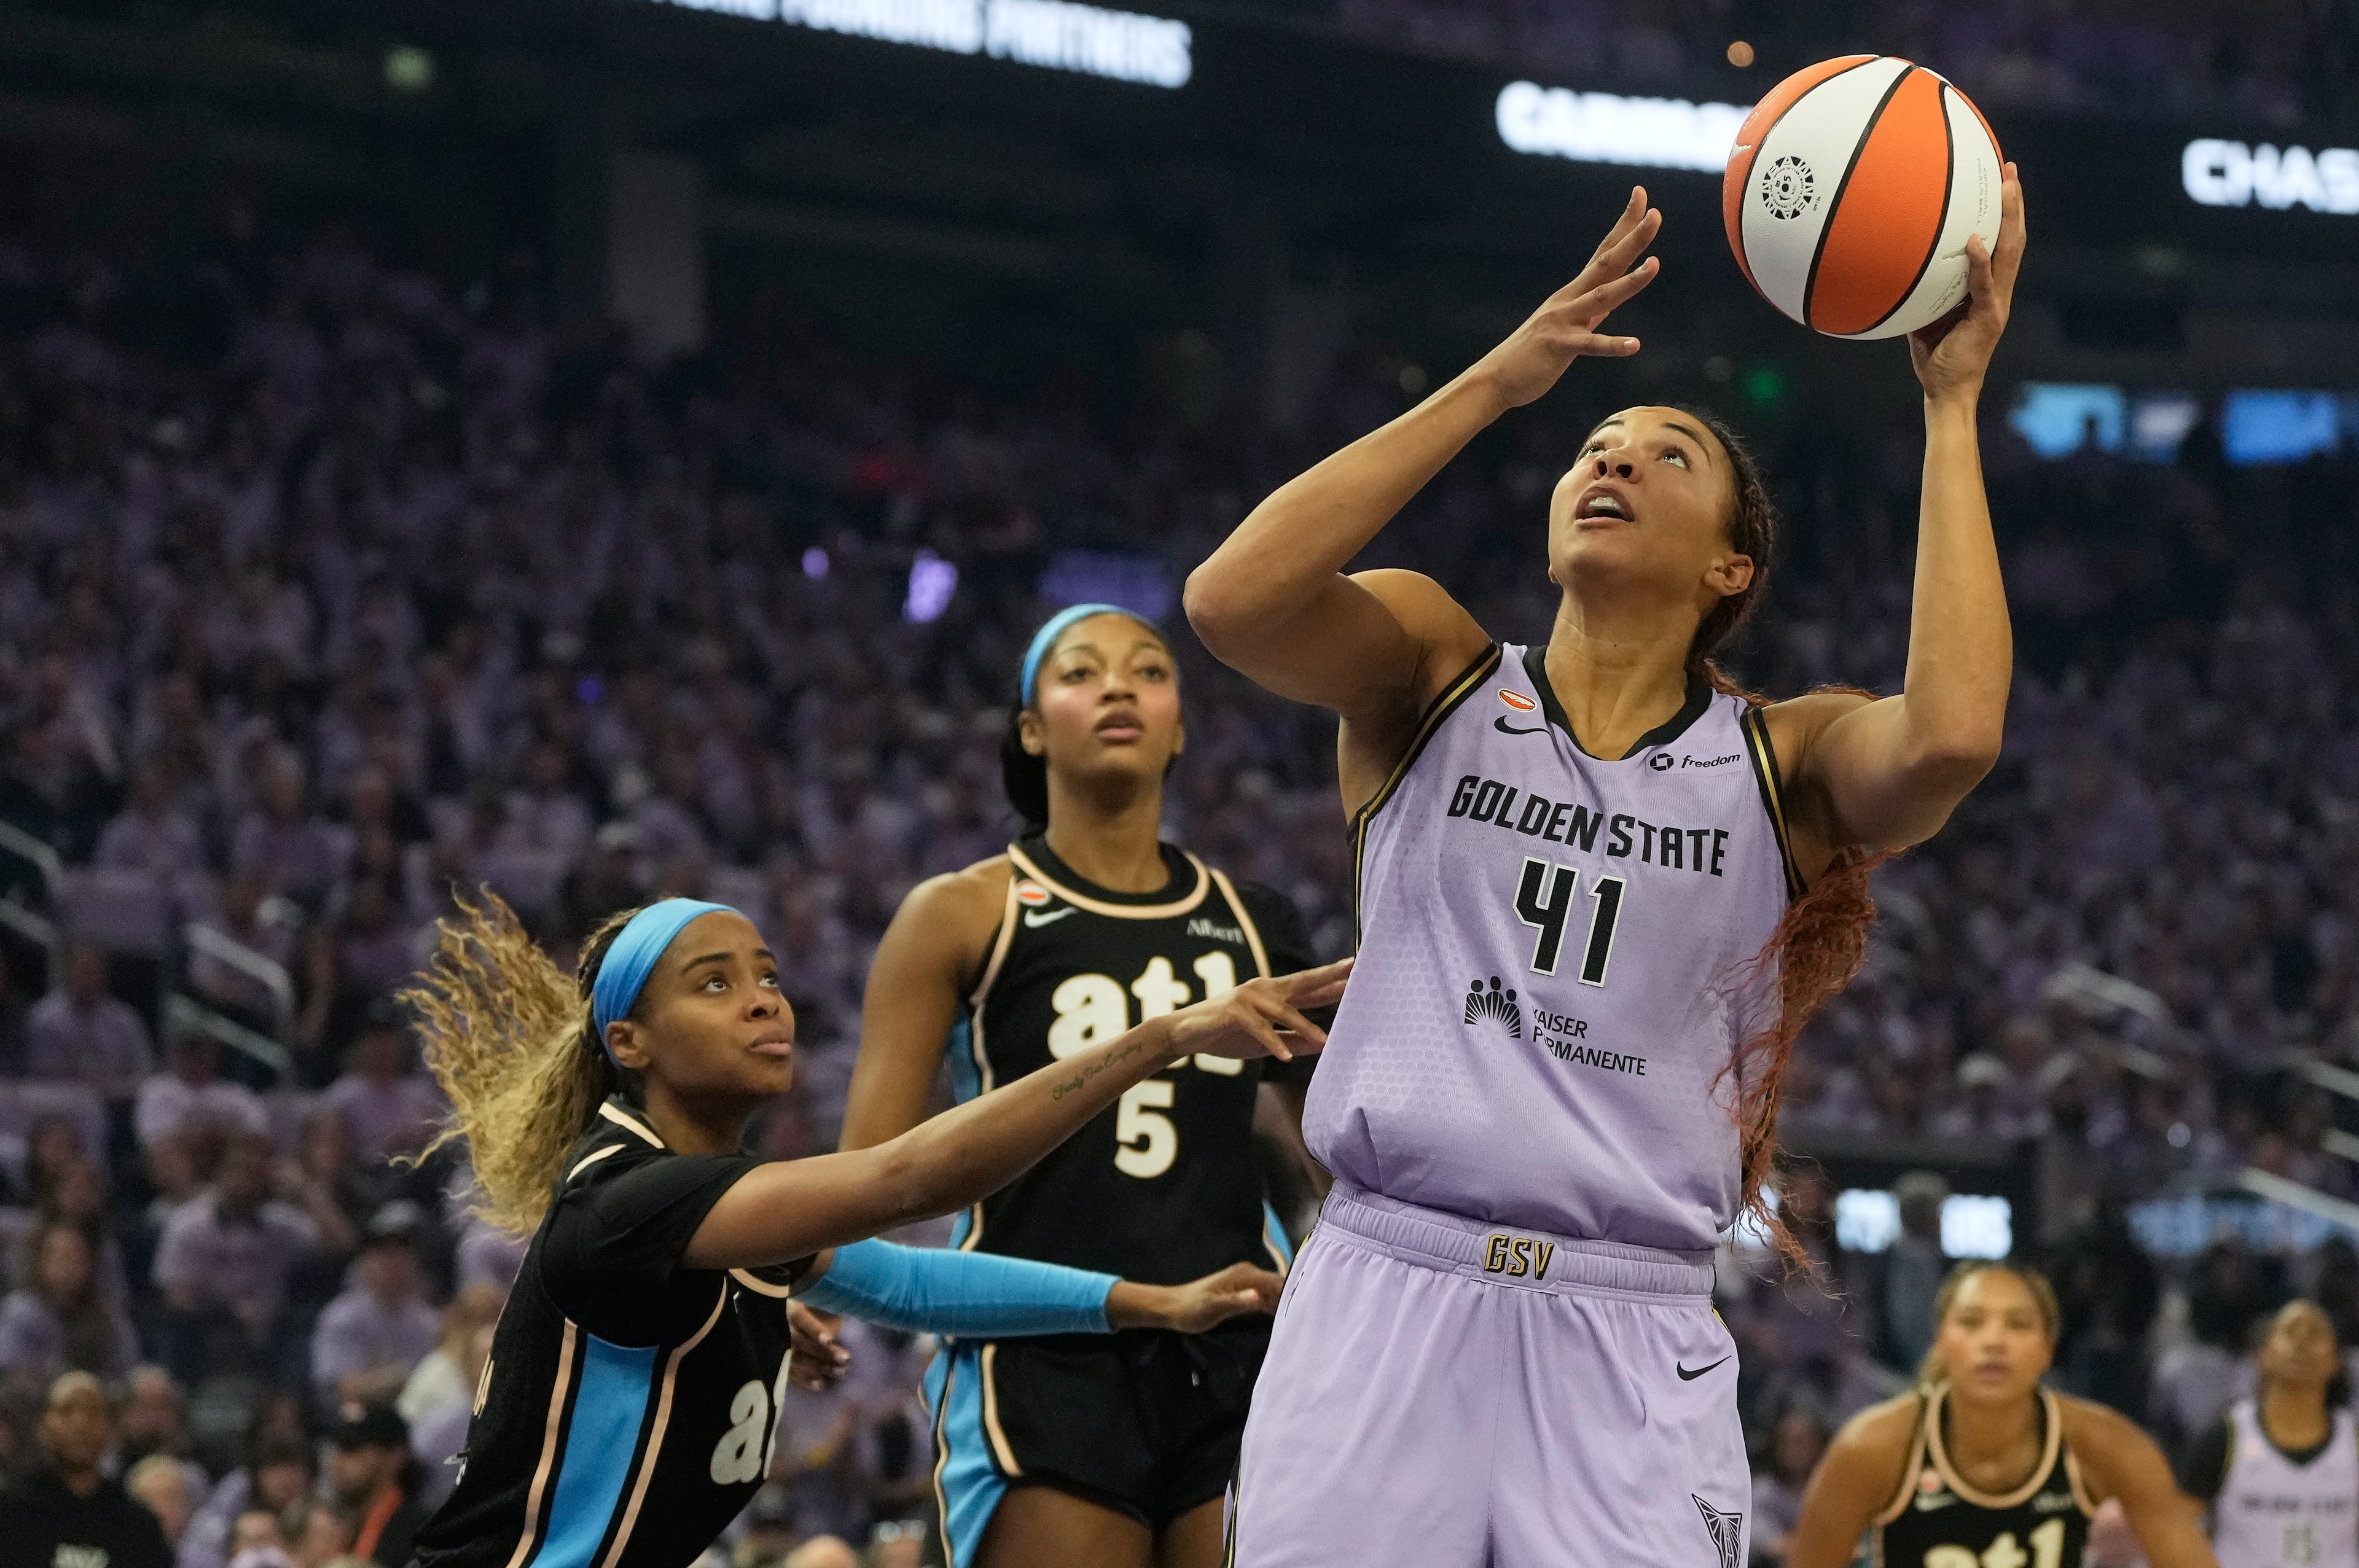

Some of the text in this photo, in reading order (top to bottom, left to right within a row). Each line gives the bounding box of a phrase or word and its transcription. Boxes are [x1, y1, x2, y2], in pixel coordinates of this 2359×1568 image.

[1681, 755, 1740, 768] freedom
[1447, 774, 1729, 877] GOLDEN STATE
[1512, 856, 1627, 988] 41
[1533, 1026, 1647, 1075] PRMANENTE
[1114, 1078, 1178, 1179] 5
[1484, 1233, 1555, 1281] GSV
